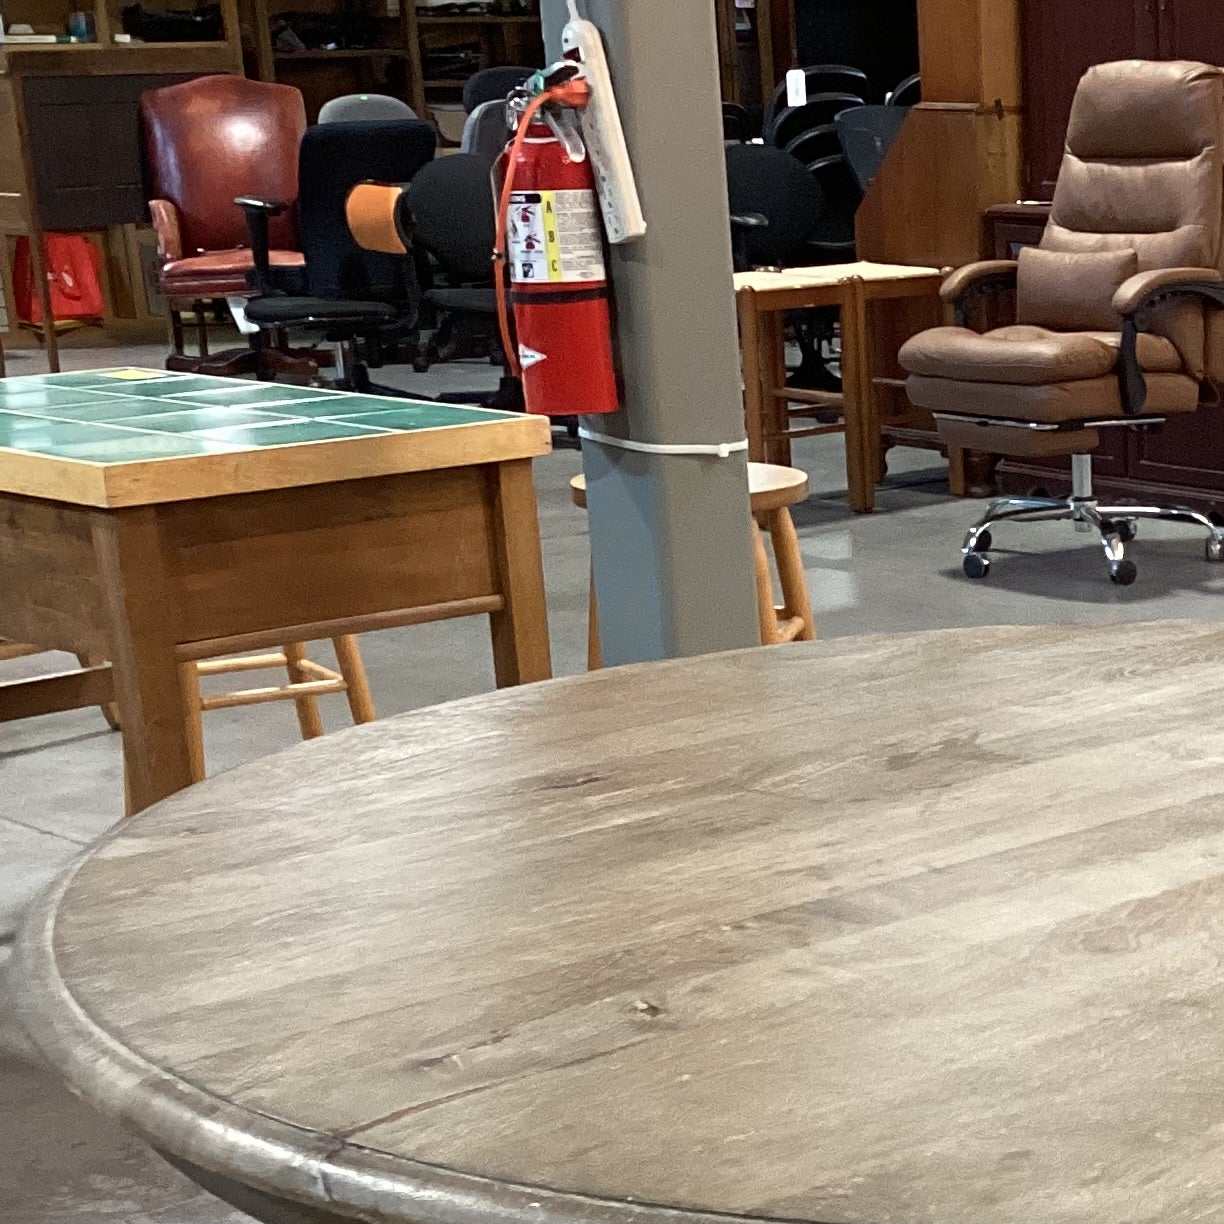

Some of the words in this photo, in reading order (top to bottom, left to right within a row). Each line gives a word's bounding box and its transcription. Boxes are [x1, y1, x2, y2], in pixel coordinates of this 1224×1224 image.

[546, 201, 552, 213] A
[548, 230, 555, 243] B
[551, 259, 558, 272] C
